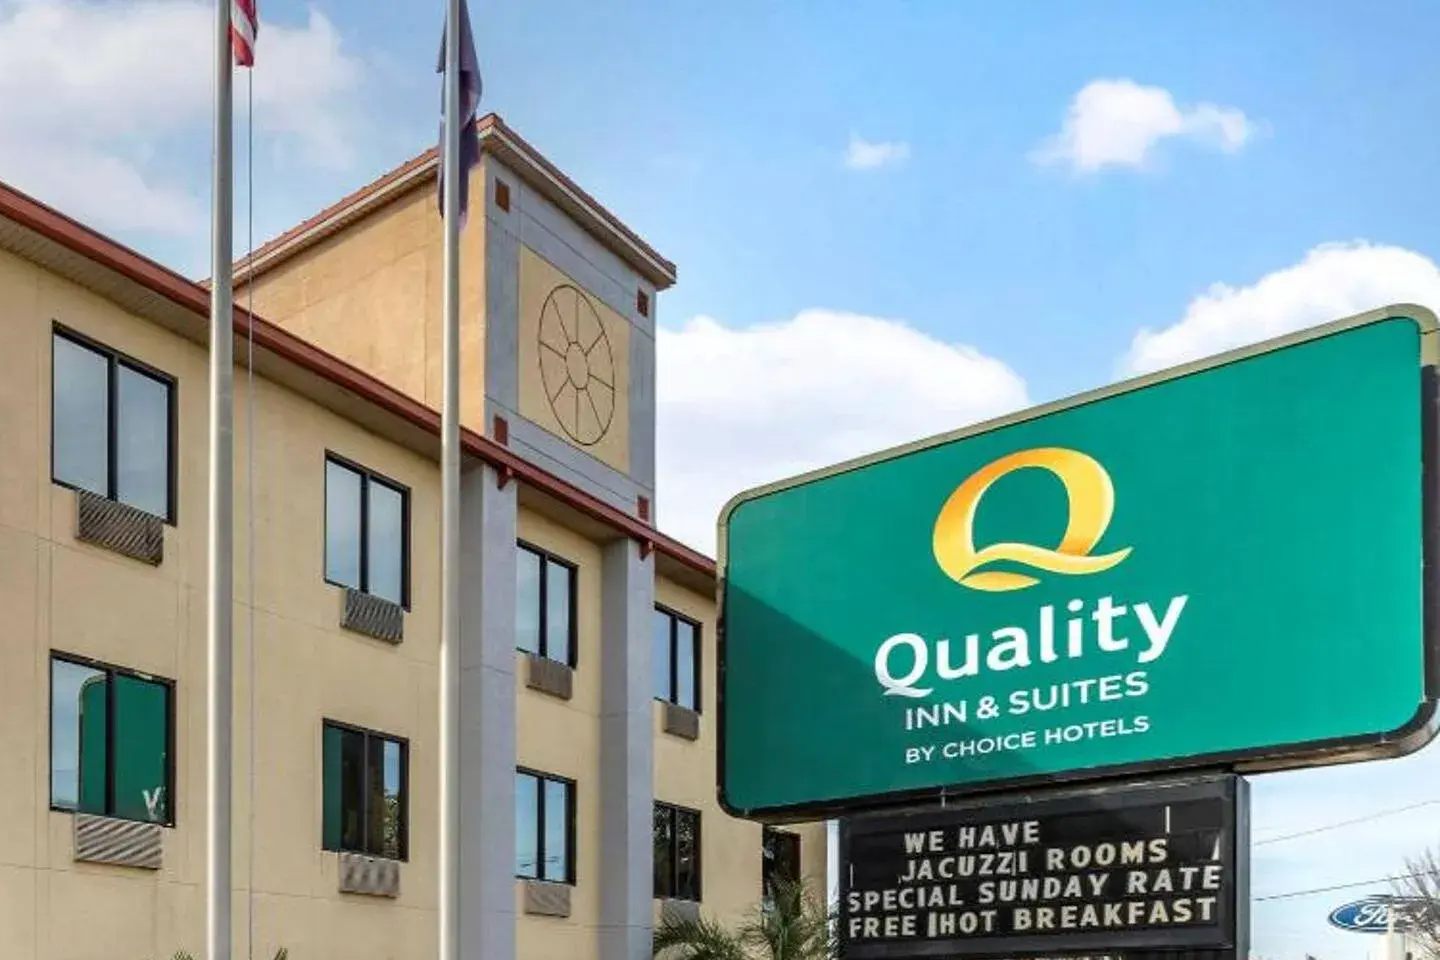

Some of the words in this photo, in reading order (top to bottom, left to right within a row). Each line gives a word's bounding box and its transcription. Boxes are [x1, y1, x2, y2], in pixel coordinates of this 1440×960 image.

[932, 447, 1134, 592] Q
[874, 594, 1188, 698] Quality
[905, 700, 967, 730] INN
[976, 695, 999, 720] &
[1008, 671, 1149, 715] SUITES
[905, 745, 935, 764] BY
[942, 731, 1036, 758] CHOICE
[1044, 715, 1150, 745] HOTELS
[901, 850, 1028, 882] JACUZZI
[1047, 838, 1169, 871] ROOMS
[904, 831, 945, 854] WE
[960, 820, 1040, 849] HAVE
[848, 887, 964, 914] SPECIAL
[979, 871, 1109, 903] SUNDAY
[1128, 865, 1224, 895] RATE
[849, 915, 917, 938] FREE
[1013, 897, 1217, 931] BREAKFAST
